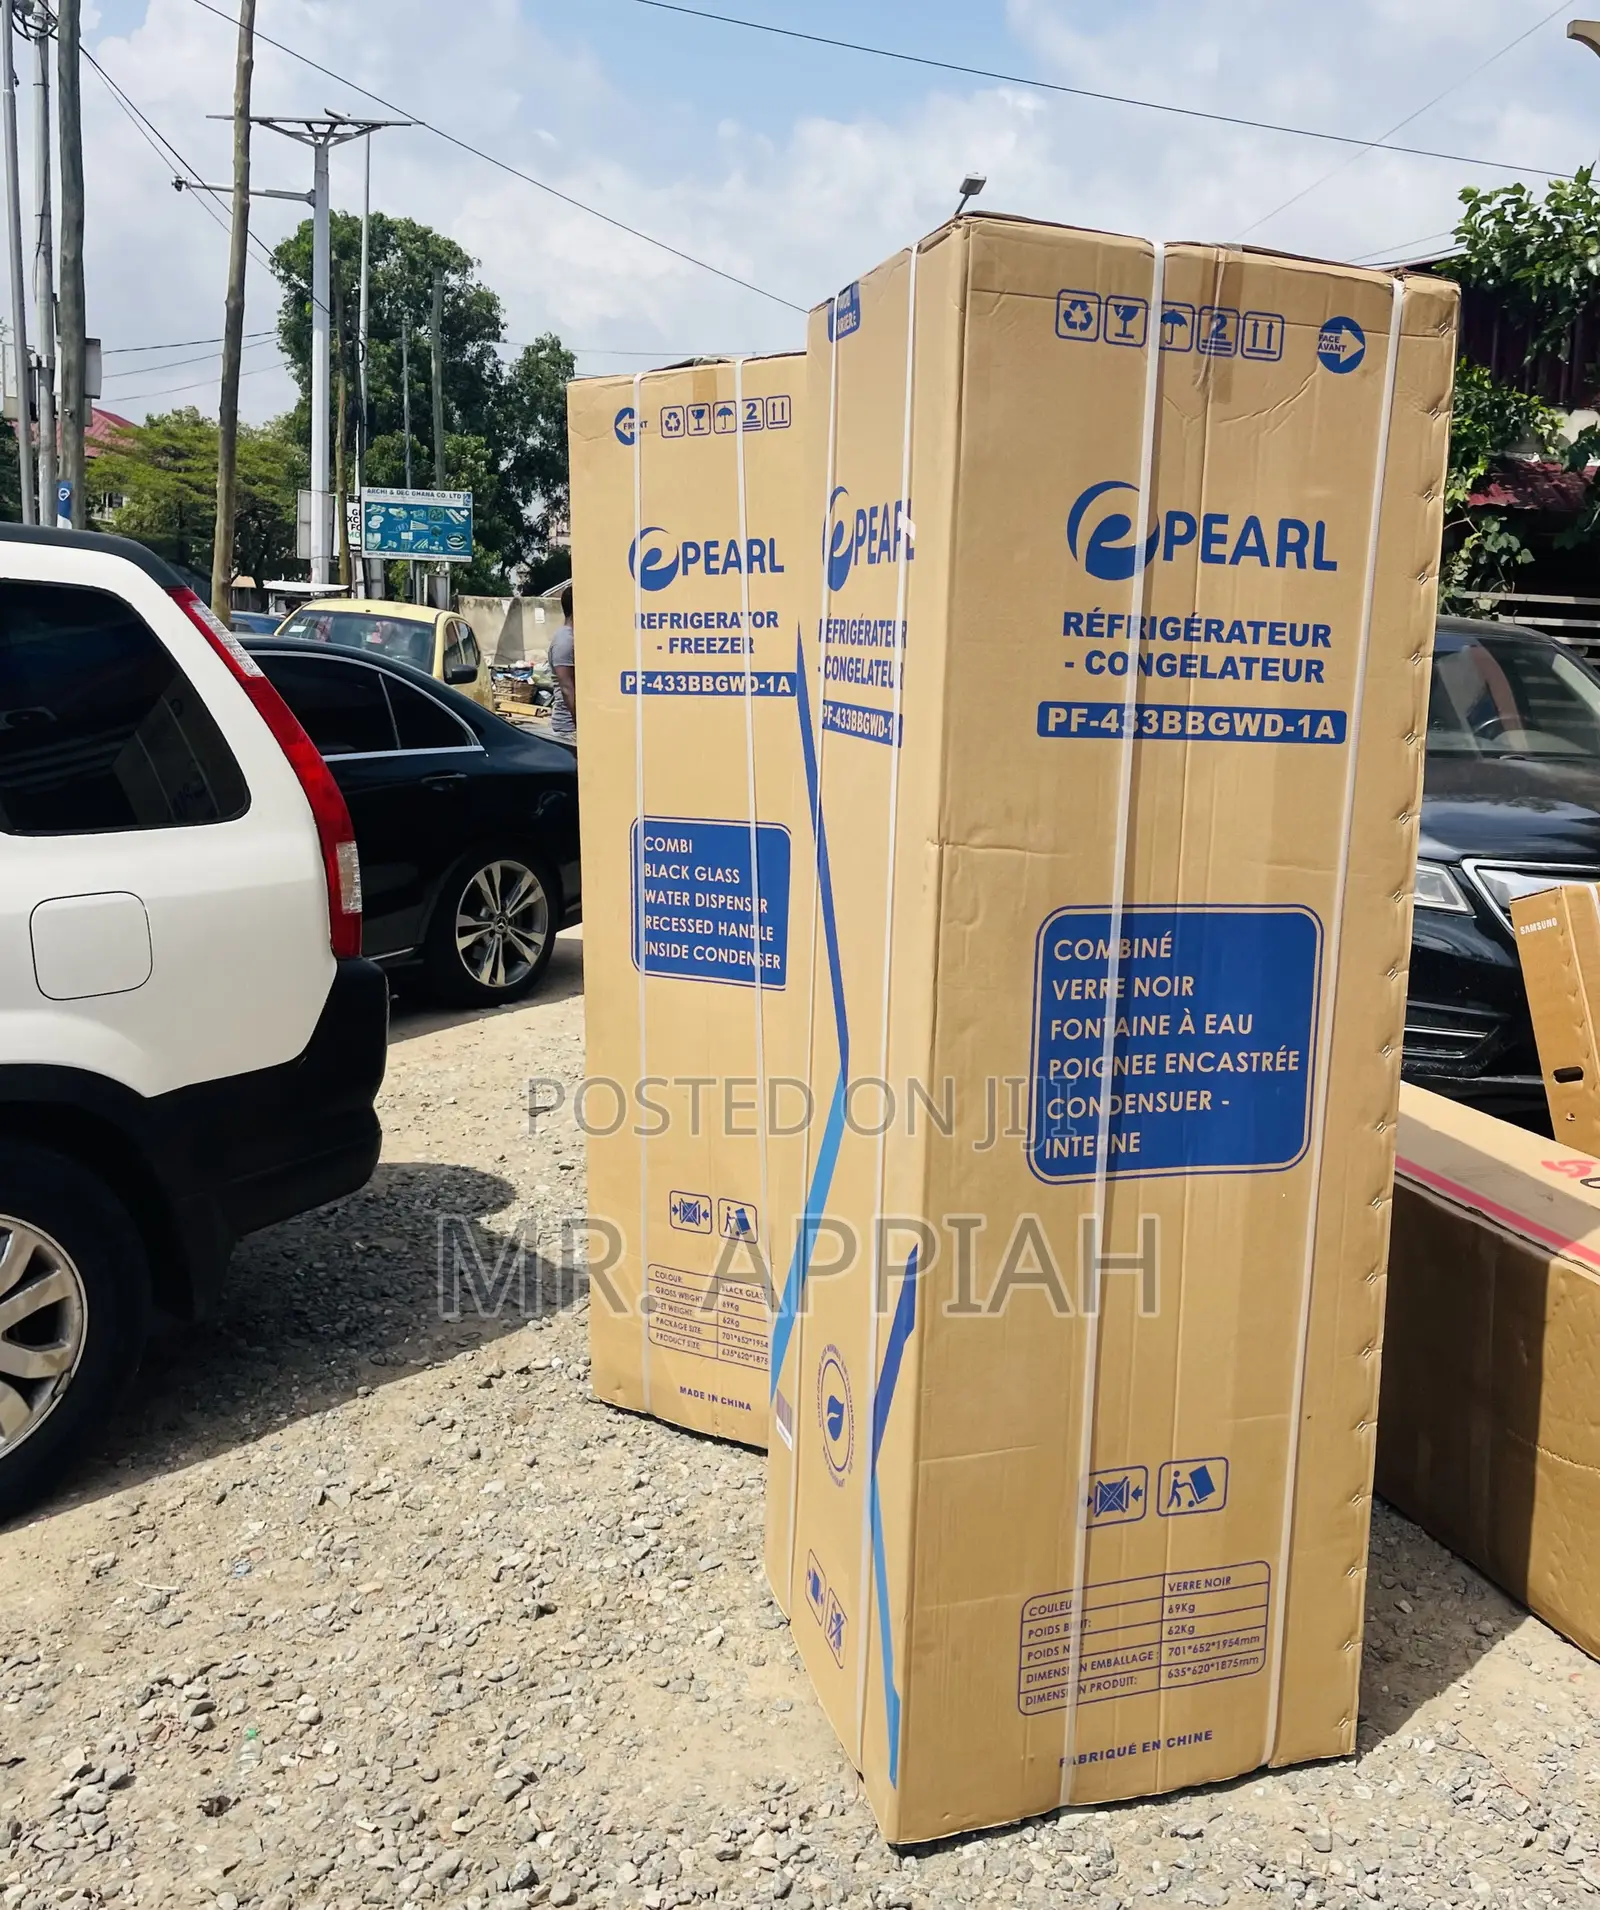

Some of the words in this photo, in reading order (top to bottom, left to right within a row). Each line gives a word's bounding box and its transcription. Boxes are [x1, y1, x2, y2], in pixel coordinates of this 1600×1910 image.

[1318, 334, 1340, 343] FACE
[1318, 343, 1347, 352] AVANT
[1162, 510, 1338, 571] PEARL
[682, 538, 785, 576] PEARL
[1063, 607, 1332, 648] RÉFRIGÉRATEUR
[1085, 650, 1325, 683] CONGELATEUR
[644, 836, 693, 853] COMBI
[644, 863, 690, 880] BLACK
[695, 866, 740, 884] GLASS
[644, 889, 690, 906] WATER
[695, 892, 768, 913] DISPENSR
[645, 915, 714, 935] RECESSED
[1520, 917, 1558, 935] SAMSUNG
[645, 941, 689, 959] INSIDE
[1054, 930, 1173, 961] COMBINÉ
[1052, 977, 1125, 1001] VERRE
[1134, 975, 1194, 998] NOIR
[1051, 1014, 1171, 1041] FONAINE
[1178, 1008, 1196, 1034] À
[1204, 1014, 1253, 1034] EAU
[1165, 1045, 1299, 1073] ENCASTRÉE
[1047, 1090, 1212, 1119] CONDENSUER
[1045, 1132, 1141, 1159] INTENE
[655, 1286, 677, 1298] GROSS
[722, 1301, 739, 1312] 69Kg
[656, 1317, 687, 1331] PACKAGE
[722, 1317, 740, 1328] 62Kg
[656, 1332, 686, 1346] PRODUCT
[680, 1386, 704, 1400] MADE
[708, 1392, 718, 1402] IN
[720, 1397, 752, 1411] CHINA
[1168, 1579, 1202, 1593] VERRE
[1204, 1576, 1232, 1589] NOIR
[1028, 1624, 1061, 1639] POIDS
[1168, 1603, 1196, 1615] 69Kg
[1027, 1646, 1060, 1662] POIDS
[1167, 1624, 1196, 1636] 62Kg
[1090, 1651, 1154, 1671] EMBALLAGE
[1090, 1676, 1138, 1693] PRODUIT:
[1142, 1739, 1161, 1753] EN
[1166, 1730, 1214, 1748] CHINE
